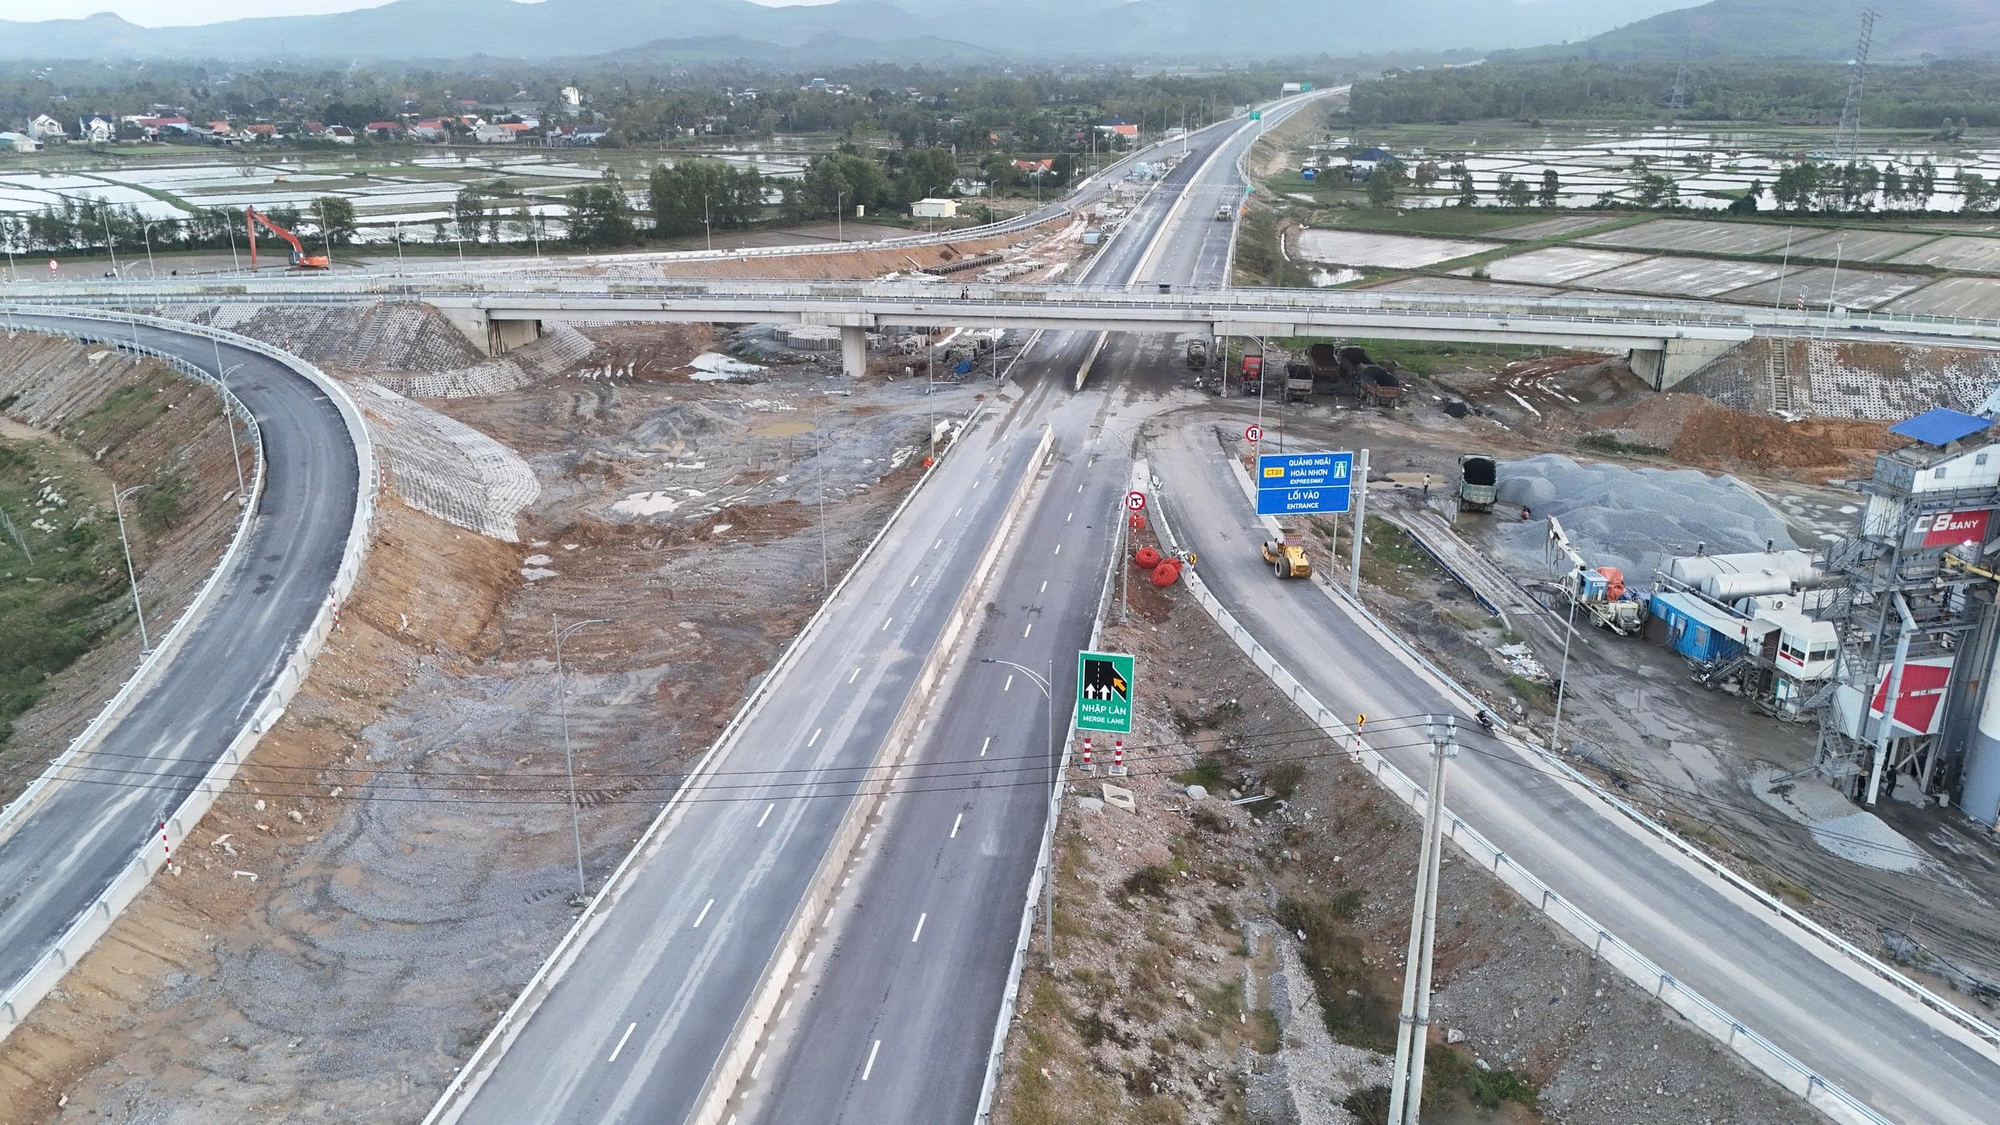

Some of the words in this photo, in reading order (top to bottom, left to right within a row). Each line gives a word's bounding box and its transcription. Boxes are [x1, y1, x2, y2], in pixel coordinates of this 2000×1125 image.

[1290, 468, 1306, 476] HOÀI
[1288, 490, 1300, 500] LỐI
[1304, 490, 1319, 500] VÀO
[1949, 520, 1978, 530] SANY
[1082, 704, 1106, 714] NHẬP
[1108, 706, 1126, 715] LÀN
